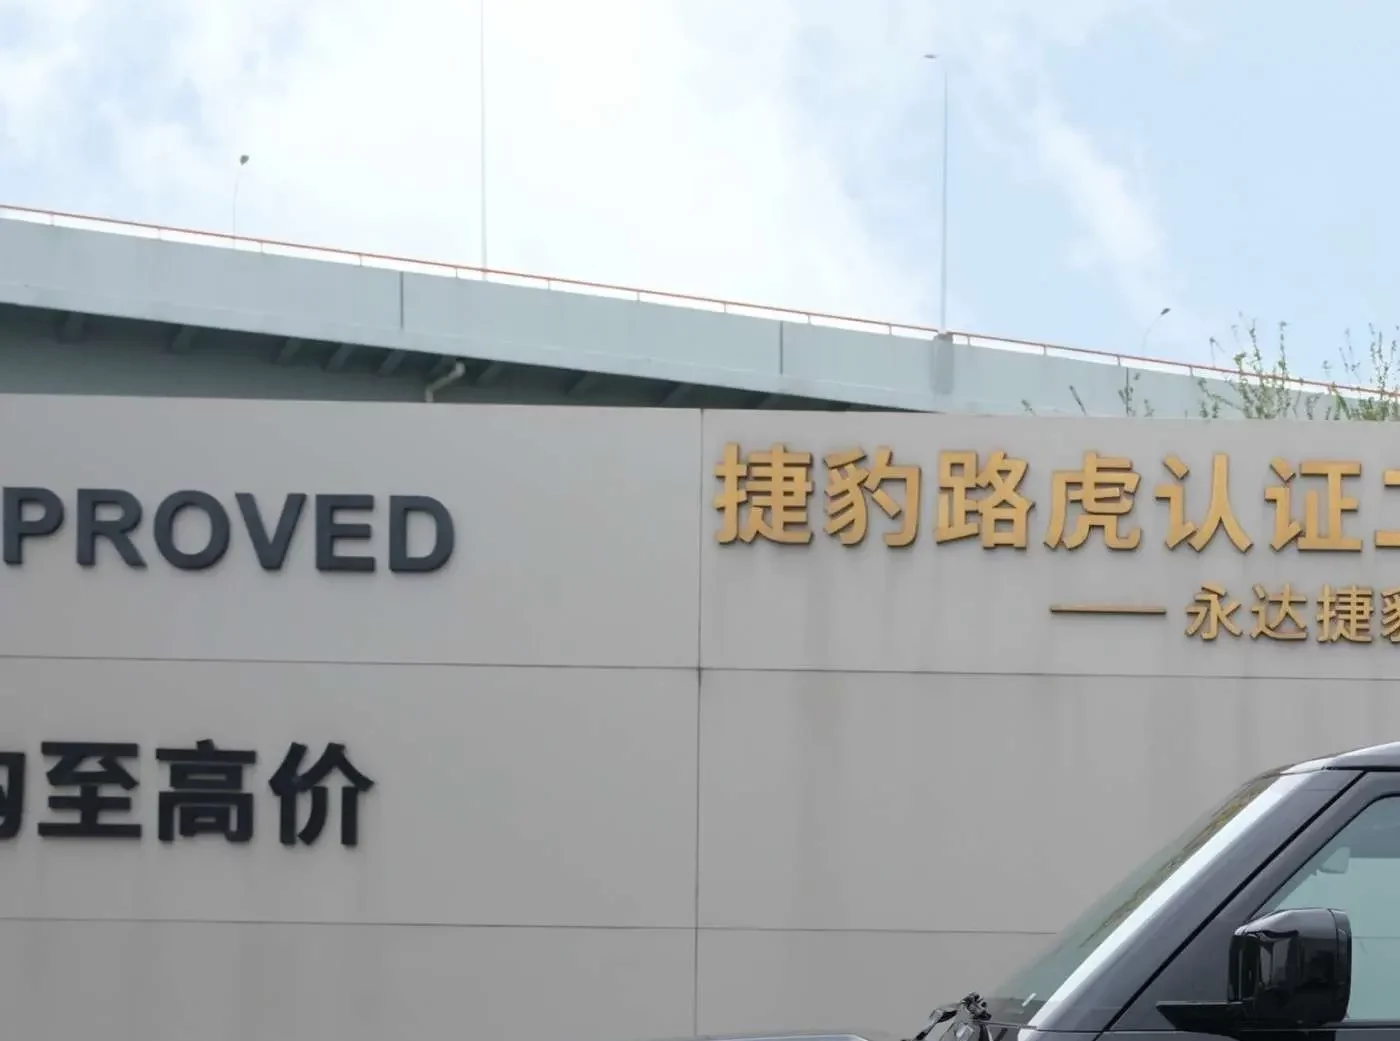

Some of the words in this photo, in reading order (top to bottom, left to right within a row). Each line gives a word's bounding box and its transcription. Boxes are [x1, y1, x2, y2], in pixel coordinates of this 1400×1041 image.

[3, 487, 456, 574] PROVED
[0, 739, 375, 848] 至高价
